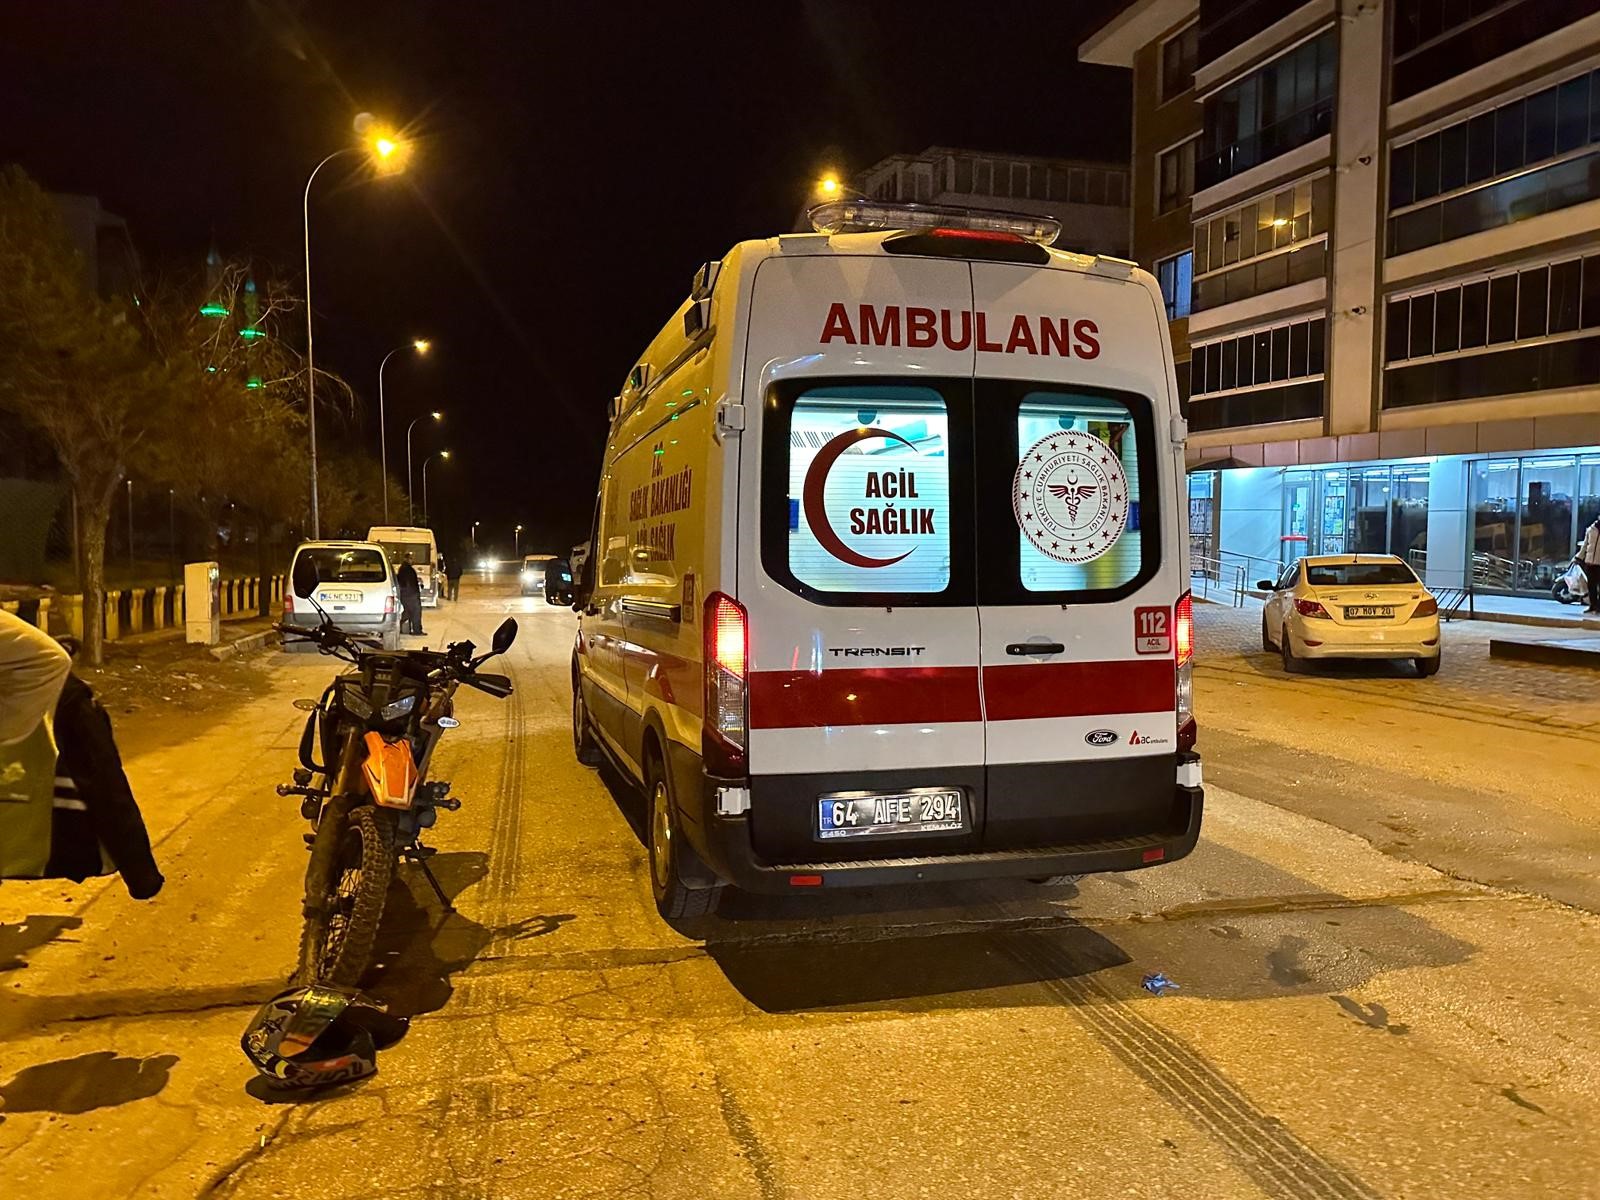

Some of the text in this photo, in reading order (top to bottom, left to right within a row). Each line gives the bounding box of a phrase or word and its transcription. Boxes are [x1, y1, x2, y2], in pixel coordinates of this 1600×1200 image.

[820, 302, 1101, 360] AMBULANS
[865, 467, 919, 498] ACİL
[849, 502, 936, 535] SAĞLIK
[1140, 611, 1166, 634] 112
[828, 647, 926, 657] TRANSIT
[832, 801, 859, 827] 64
[873, 798, 912, 824] AFE
[921, 795, 957, 821] 294
